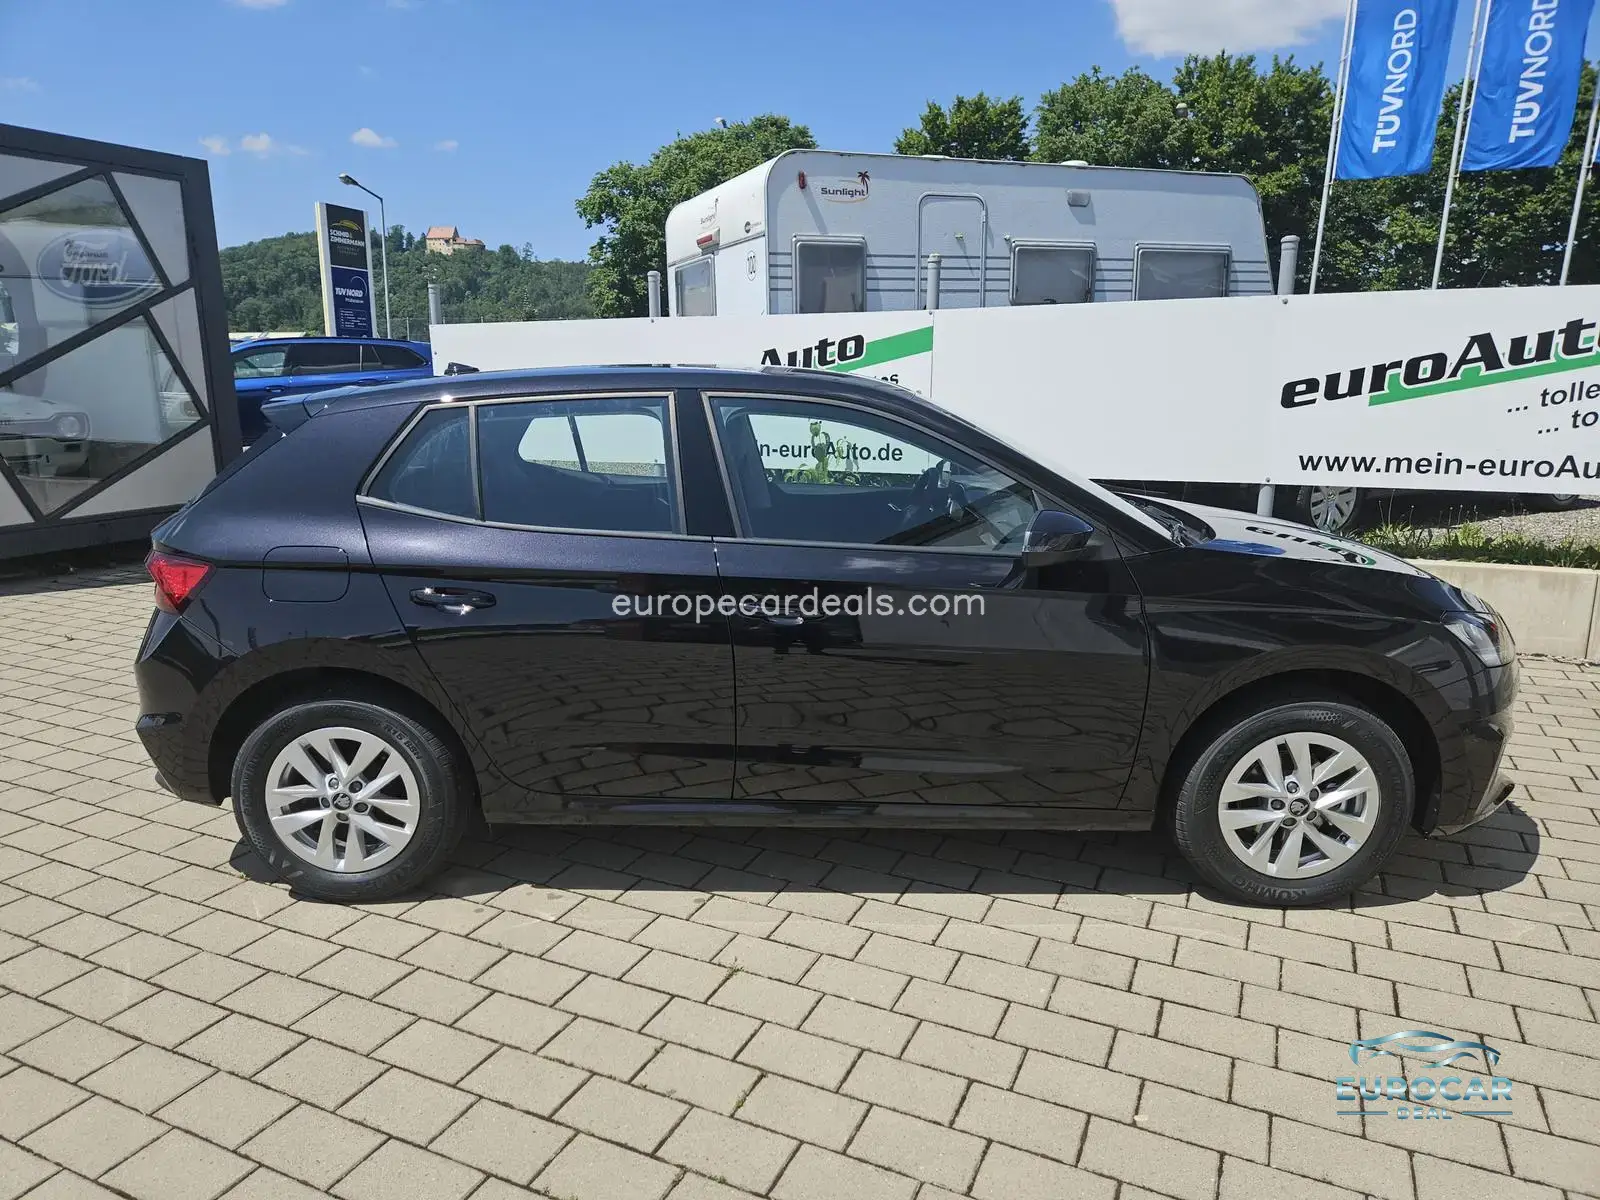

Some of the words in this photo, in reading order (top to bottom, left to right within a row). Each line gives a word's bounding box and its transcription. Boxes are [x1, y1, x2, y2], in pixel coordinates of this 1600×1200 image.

[821, 186, 866, 198] Sunlight
[1280, 318, 1600, 409] euroAut
[1540, 381, 1600, 407] tolle
[1572, 410, 1599, 429] to
